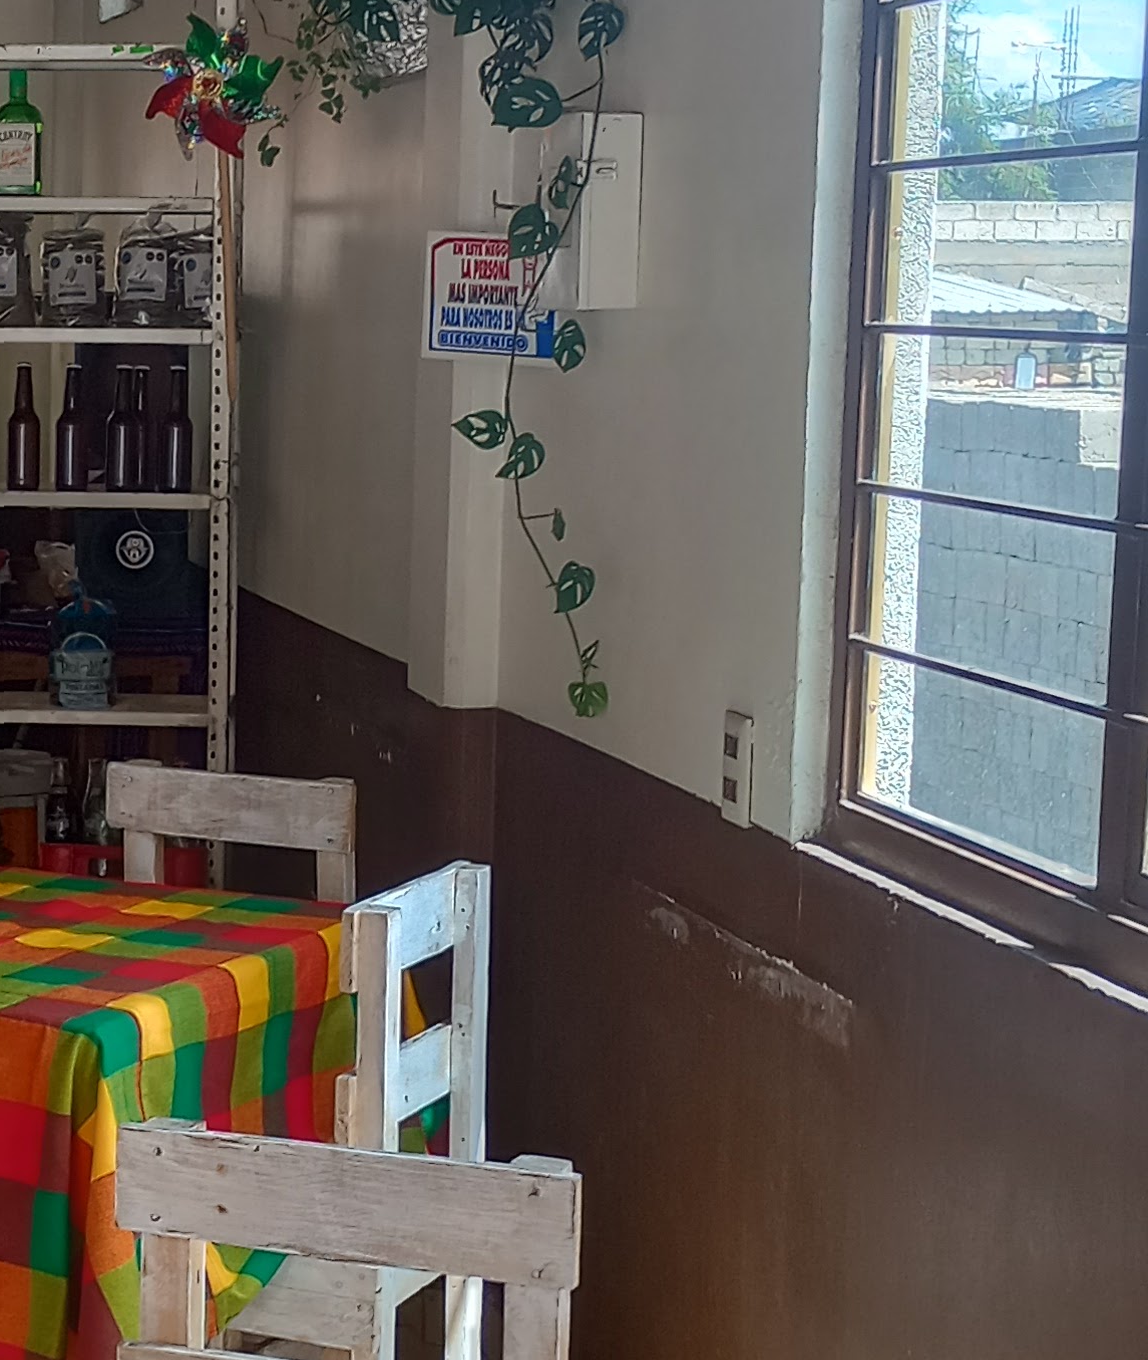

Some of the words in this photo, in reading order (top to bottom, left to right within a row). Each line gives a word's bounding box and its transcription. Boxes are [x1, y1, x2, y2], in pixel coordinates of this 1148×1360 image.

[453, 243, 464, 255] EN
[466, 243, 482, 256] ESTE
[485, 243, 510, 257] NEGO
[461, 258, 471, 279] LA
[473, 259, 510, 281] PERSONA
[448, 283, 466, 303] MAS
[468, 283, 518, 306] IMPORTANTE
[441, 306, 460, 327] PARA
[463, 307, 503, 330] NOSOTROS
[504, 309, 513, 330] ES
[440, 332, 528, 351] BIENVENIDO
